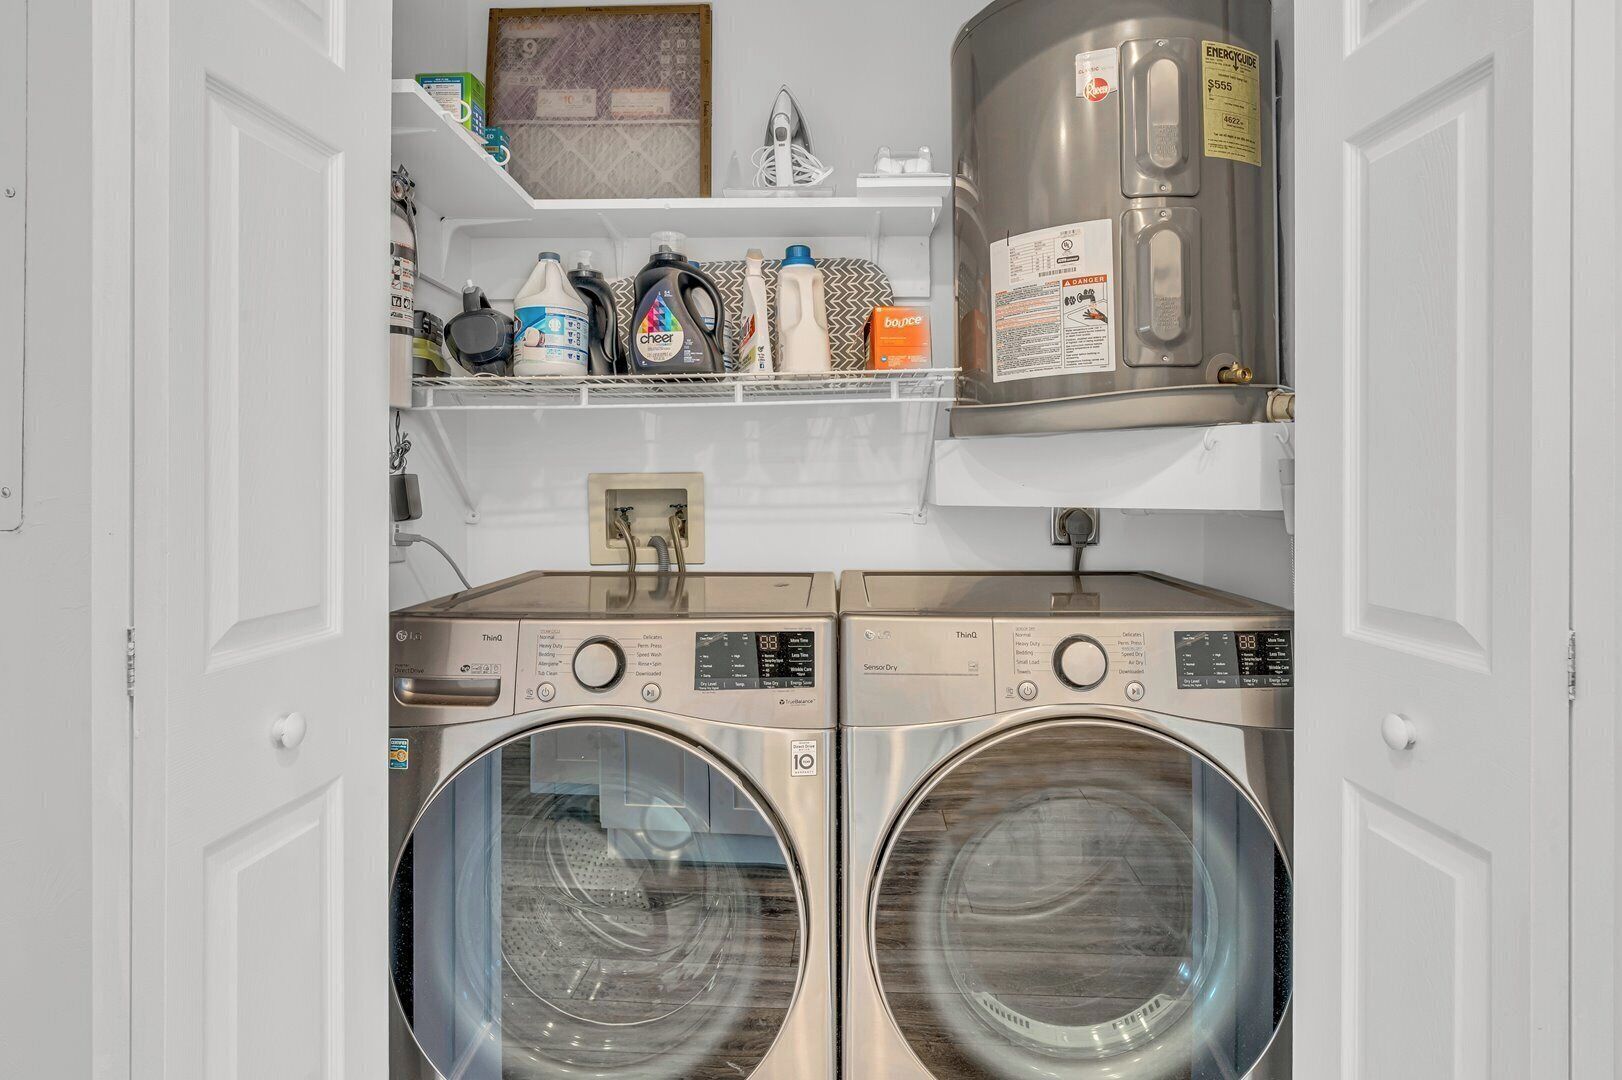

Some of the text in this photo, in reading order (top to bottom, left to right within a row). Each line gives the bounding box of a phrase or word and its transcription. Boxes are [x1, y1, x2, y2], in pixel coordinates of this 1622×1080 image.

[1206, 46, 1256, 72] ENERGYGUIDE
[1208, 78, 1232, 92] $555
[1072, 276, 1105, 285] DANGER
[885, 316, 921, 328] bounce
[640, 332, 674, 344] cheer
[794, 754, 814, 769] 10
